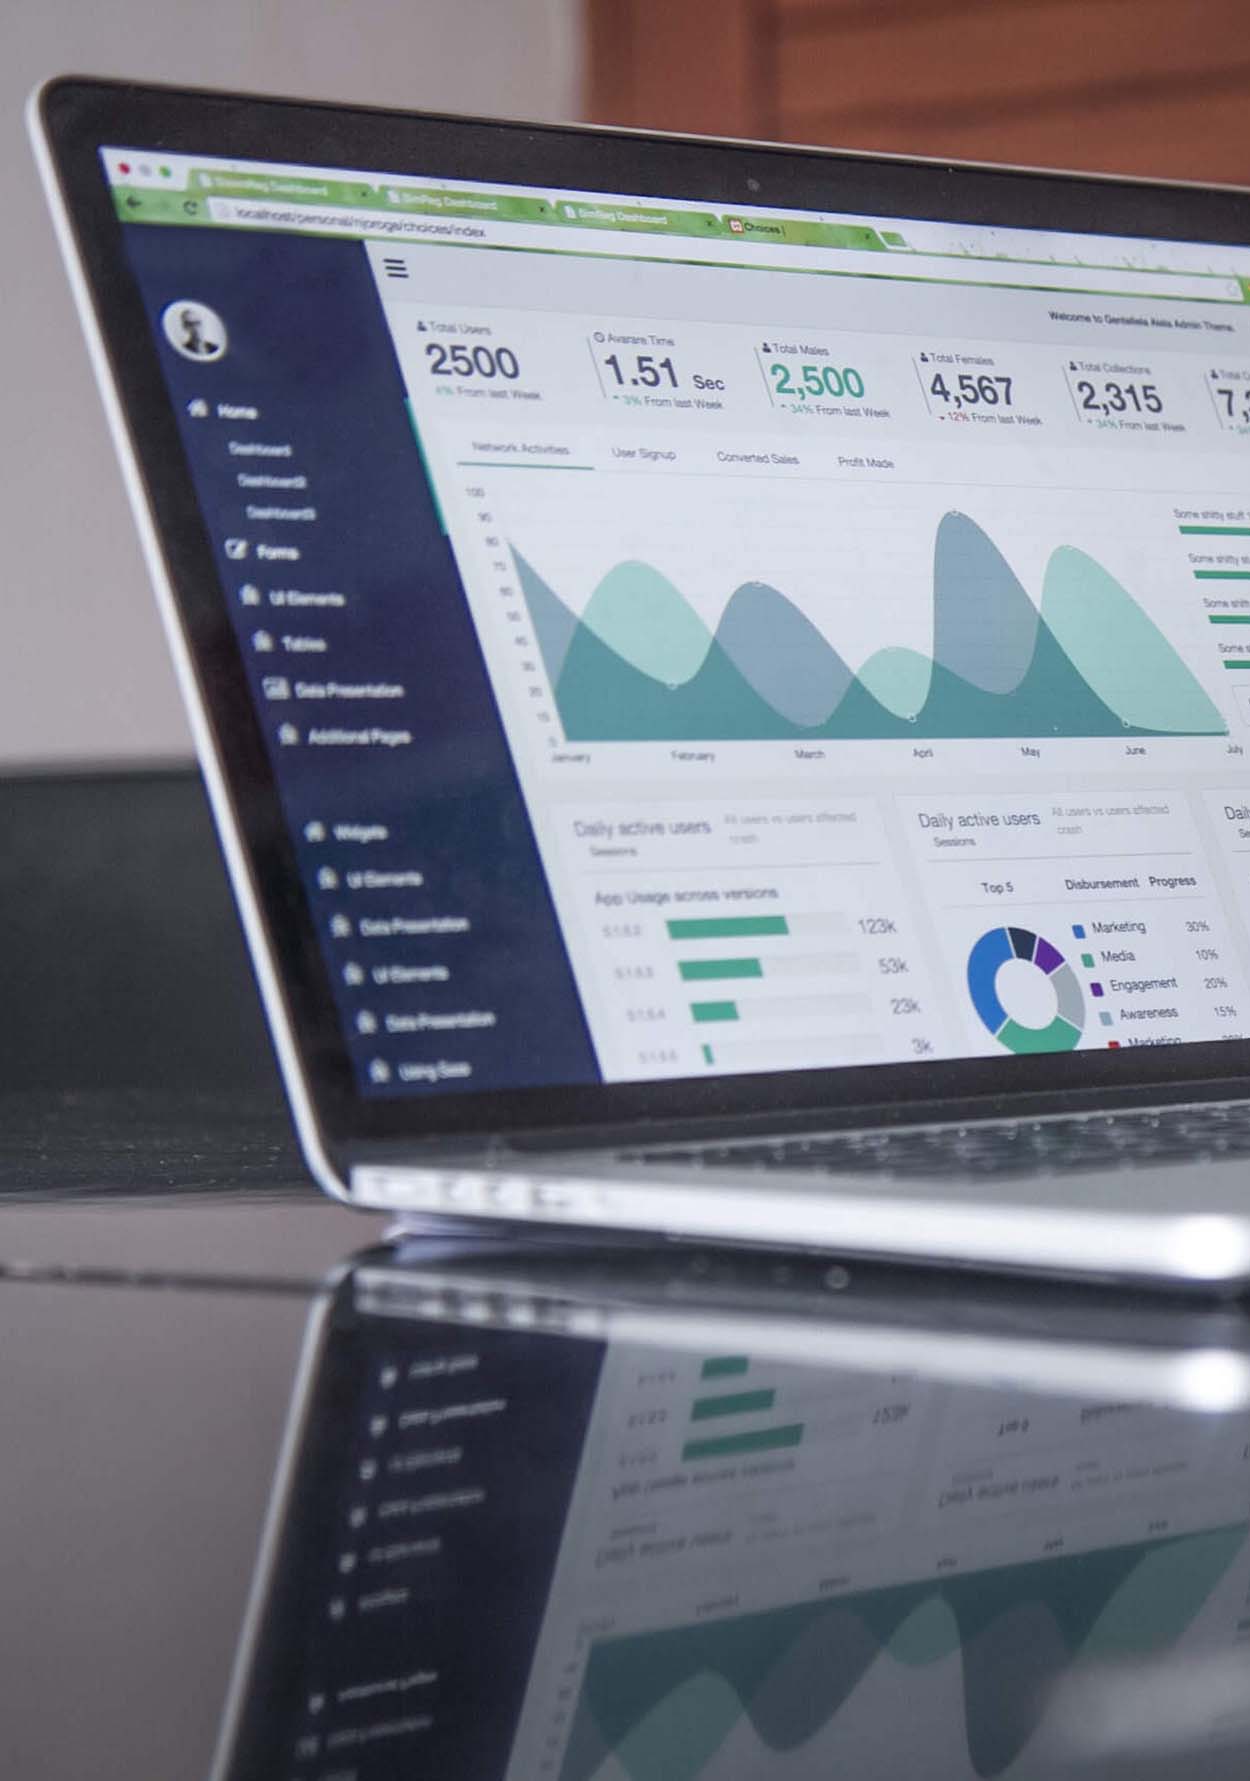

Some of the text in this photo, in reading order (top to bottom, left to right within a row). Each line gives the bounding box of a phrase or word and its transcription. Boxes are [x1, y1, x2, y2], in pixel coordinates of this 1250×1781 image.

[744, 221, 781, 235] Choices
[1048, 311, 1091, 323] Welcome
[428, 321, 492, 336] Total Users
[648, 335, 675, 347] Time
[772, 342, 830, 357] Total Males
[425, 343, 520, 380] 2500
[928, 352, 995, 367] Total Females
[604, 353, 725, 391] 1.51 Sec
[1078, 361, 1152, 376] Total Collections
[1219, 369, 1242, 381] Total
[770, 363, 865, 401] 2,500
[930, 373, 1013, 409] 4,567
[644, 396, 673, 408] From
[693, 399, 724, 410] Week
[1077, 381, 1163, 417] 2,315
[217, 403, 259, 420] Home
[816, 405, 841, 417] From
[843, 406, 862, 418] last
[864, 407, 890, 419] Week
[948, 411, 1043, 427] 12% From last Week
[1118, 420, 1143, 432] From
[612, 447, 676, 463] User Signup
[716, 451, 800, 466] Converted Sales
[838, 456, 895, 470] Profit Made
[1173, 508, 1200, 520] Some
[1201, 509, 1225, 522] shitty
[1226, 510, 1246, 521] stuff
[1188, 552, 1215, 565] Some
[1216, 554, 1239, 567] shitty
[1203, 597, 1230, 609] Some
[1217, 642, 1244, 654] Some
[794, 748, 825, 760] March
[912, 747, 934, 760] April
[1020, 746, 1041, 759] May
[1124, 745, 1146, 757] June
[1227, 744, 1244, 756] July
[918, 811, 1041, 831] Daily active users
[572, 819, 712, 840] Daily active users
[933, 835, 976, 848] Sessions
[980, 881, 1014, 896] Top 5
[1065, 877, 1140, 891] Disbursement
[1148, 875, 1198, 890] Progress
[595, 886, 779, 907] App Usage across versions
[857, 918, 897, 935] 123k
[1092, 921, 1147, 936] Marketing
[1184, 920, 1211, 933] 30%
[1100, 950, 1136, 964] Media
[1195, 949, 1219, 962] 10%
[878, 957, 909, 975] 53k
[1110, 977, 1178, 994] Engagement
[1203, 977, 1229, 990] 20%
[890, 997, 921, 1015] 23k
[1119, 1006, 1179, 1021] Awareness
[1213, 1006, 1238, 1018] 15%
[911, 1037, 935, 1055] 3k
